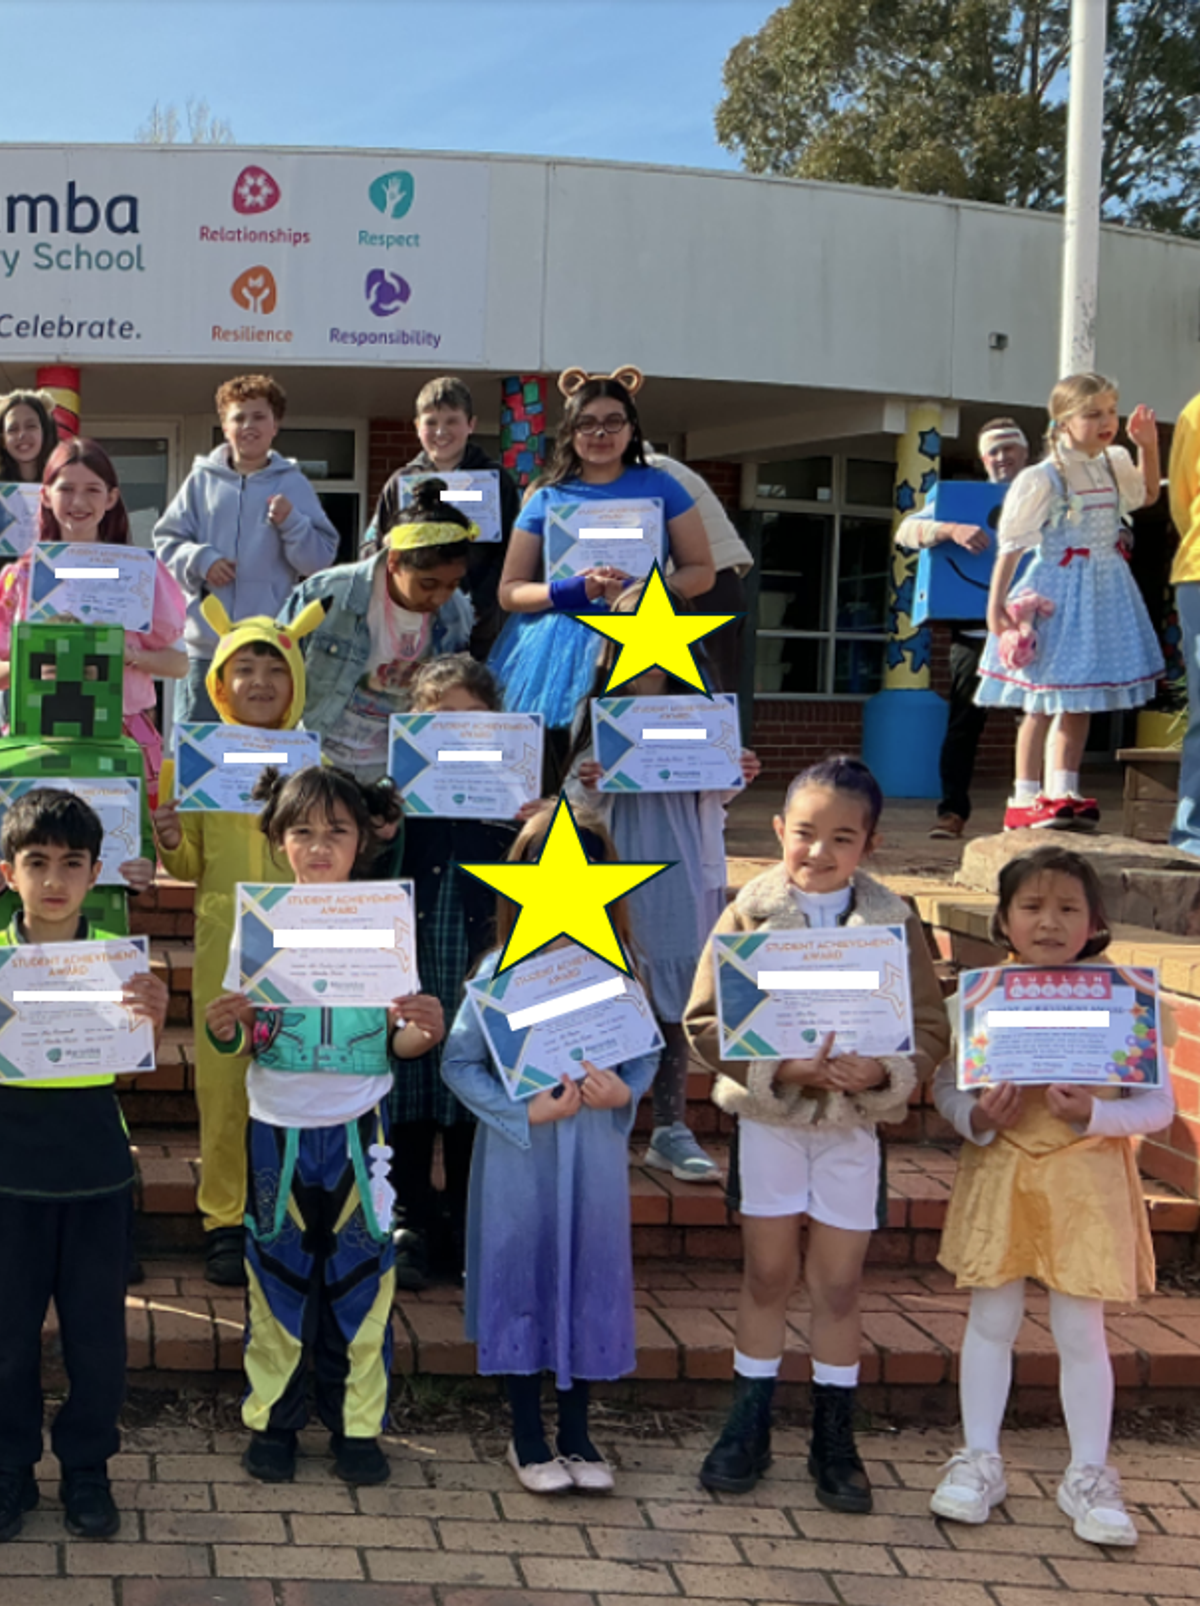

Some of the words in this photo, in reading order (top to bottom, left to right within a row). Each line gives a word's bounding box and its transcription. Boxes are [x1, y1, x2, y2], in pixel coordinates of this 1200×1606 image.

[199, 225, 311, 247] Relationships
[358, 230, 420, 249] Respect
[33, 243, 146, 272] School
[211, 325, 293, 343] Resilience
[329, 327, 441, 348] Responsibility
[287, 895, 333, 906] STUDENT
[335, 893, 405, 905] ACHIEVEMENT
[321, 905, 358, 914] AWARD
[765, 942, 814, 952] STUDENT
[817, 938, 895, 950] ACHIEVEMENT
[12, 955, 60, 969] STUDENT
[63, 949, 138, 965] ACHIEVEMENT
[802, 950, 843, 961] AWARD
[48, 965, 89, 977] AWARD
